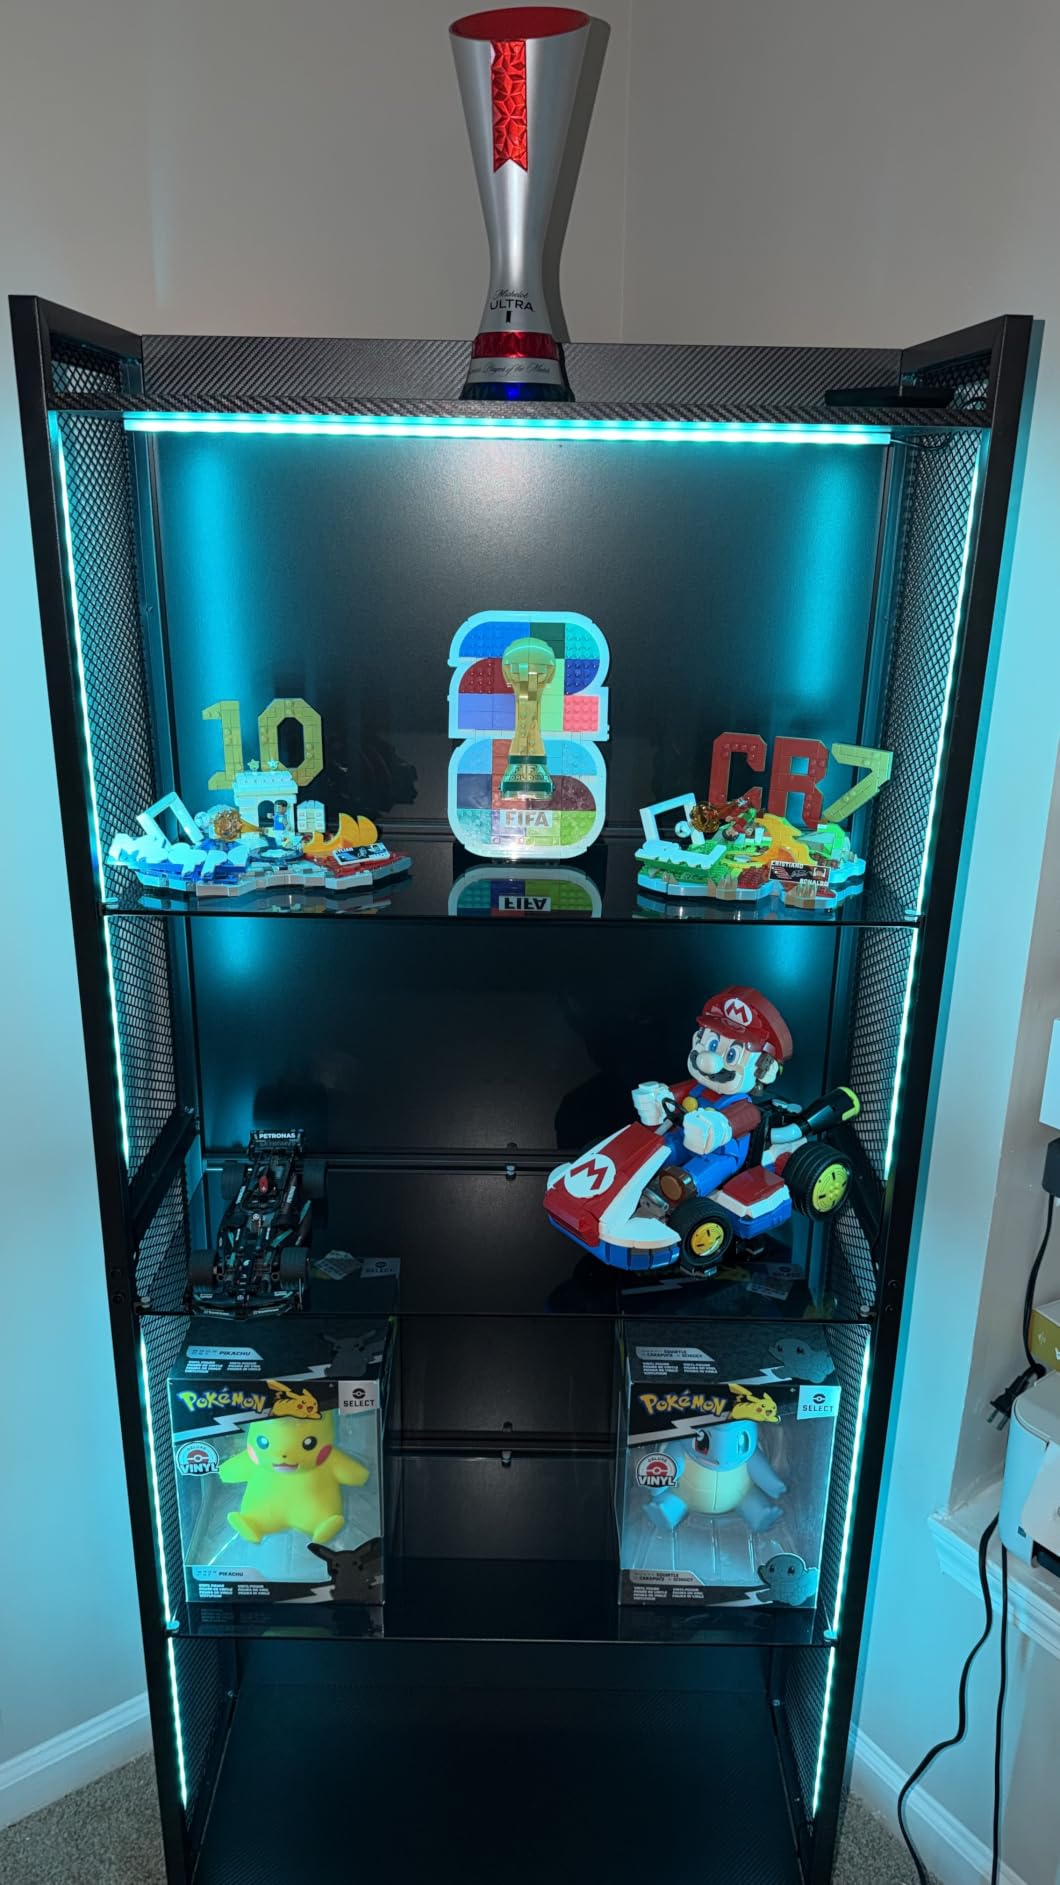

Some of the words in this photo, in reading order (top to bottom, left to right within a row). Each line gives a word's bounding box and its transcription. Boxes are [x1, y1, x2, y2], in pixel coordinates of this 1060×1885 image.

[489, 299, 534, 312] ULTRA
[202, 698, 323, 790] 10
[708, 732, 894, 830] CR7
[505, 811, 549, 827] FIFA
[771, 861, 804, 870] CRISTIANO
[343, 1399, 375, 1407] SELECT
[180, 1462, 219, 1474] VINYL
[638, 1475, 675, 1486] VINYL
